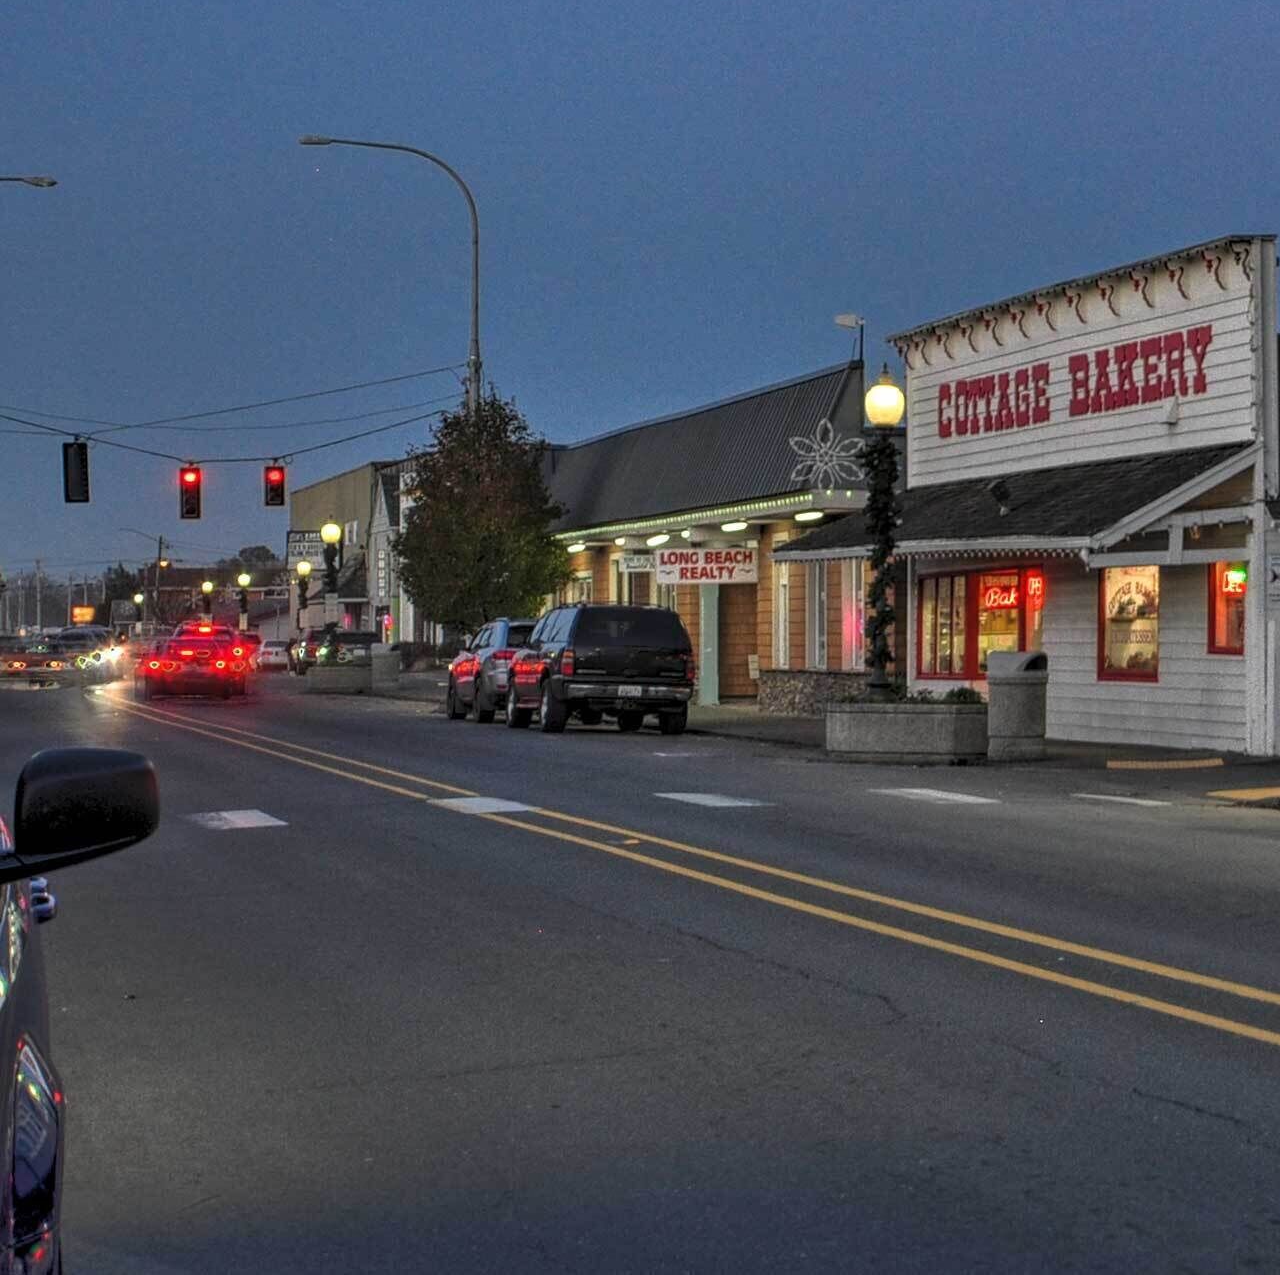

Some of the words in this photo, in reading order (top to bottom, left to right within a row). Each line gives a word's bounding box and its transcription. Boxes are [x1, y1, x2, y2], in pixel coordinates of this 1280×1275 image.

[939, 362, 1050, 438] COTTAGE
[1068, 324, 1213, 418] BAKERY
[659, 551, 699, 566] LONG
[703, 551, 753, 566] BEACH
[678, 565, 737, 580] REALTY
